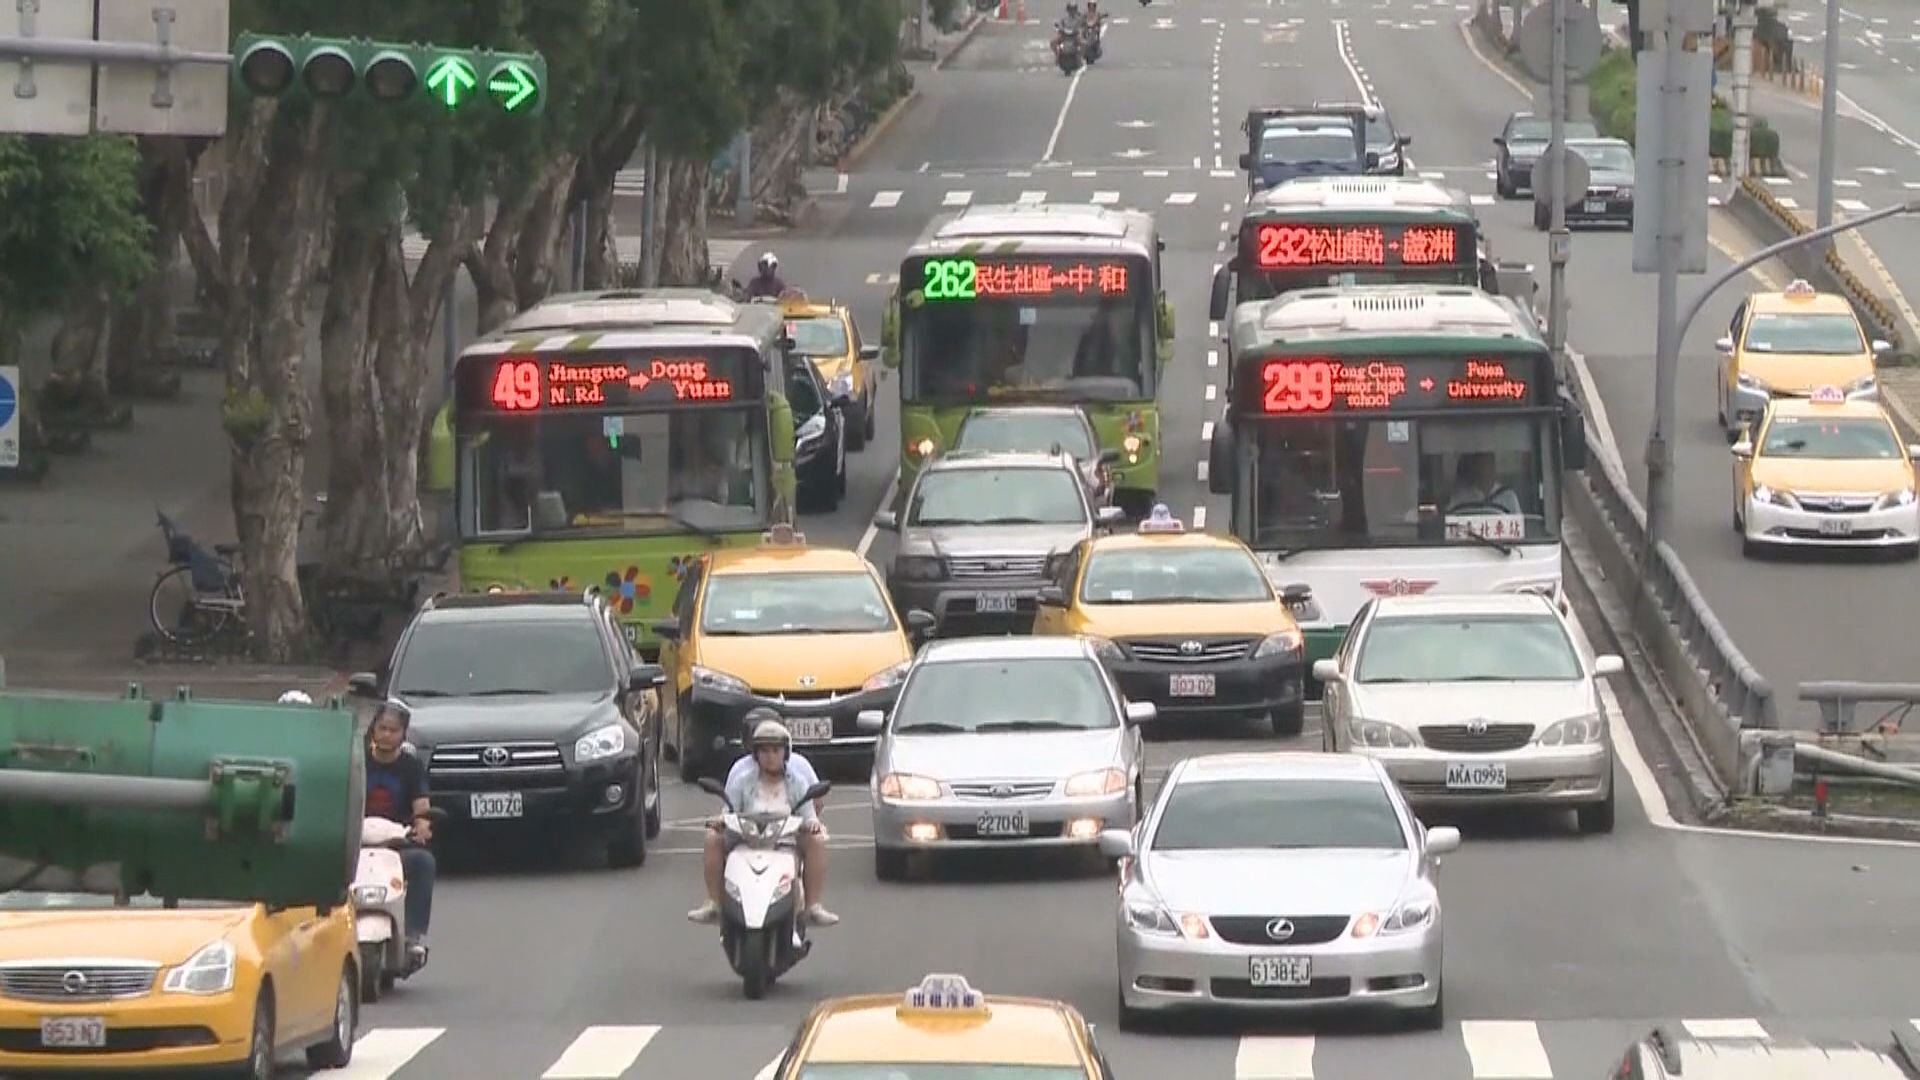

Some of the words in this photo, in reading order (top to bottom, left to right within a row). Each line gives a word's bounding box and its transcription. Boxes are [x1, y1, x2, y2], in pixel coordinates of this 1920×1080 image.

[1260, 227, 1310, 265] 232
[924, 260, 976, 297] 262
[975, 264, 1052, 293] 民生社區
[549, 364, 628, 383] Jianguo
[650, 360, 707, 381] Dong
[1330, 364, 1366, 380] Yong
[1367, 362, 1405, 378] Chun
[493, 361, 541, 409] 49
[550, 387, 571, 403] N.
[575, 386, 605, 403] Rd.
[673, 380, 731, 399] Yuan
[1263, 362, 1332, 411] 299
[1375, 376, 1405, 394] high
[1447, 381, 1526, 399] University
